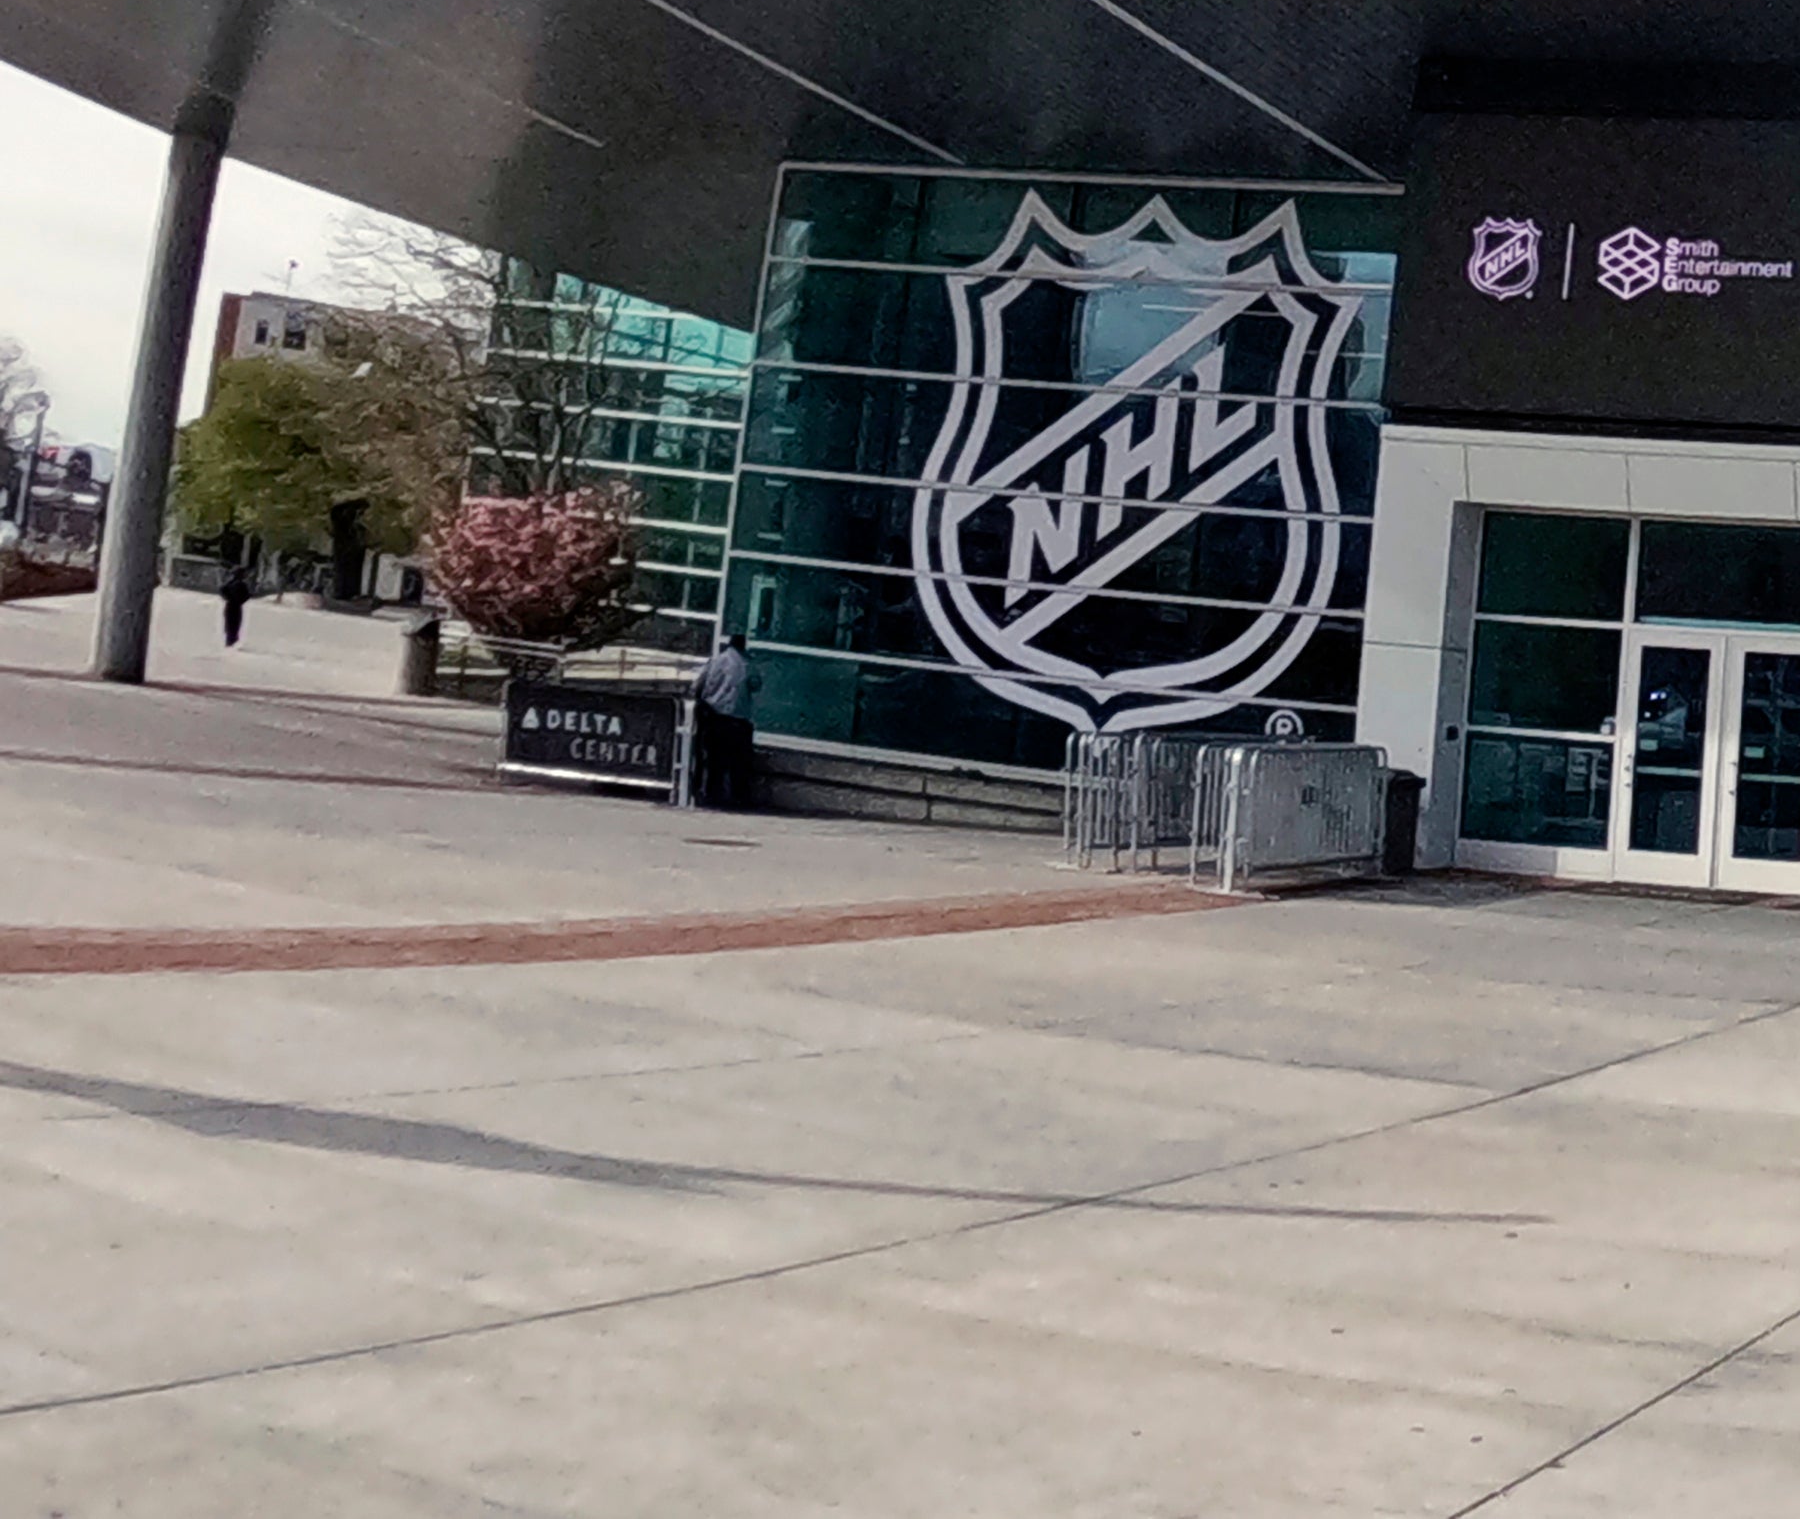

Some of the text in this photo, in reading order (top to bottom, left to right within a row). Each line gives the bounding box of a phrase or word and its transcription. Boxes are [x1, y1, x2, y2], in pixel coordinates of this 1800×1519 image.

[1483, 241, 1526, 280] NHL
[1665, 237, 1719, 257] Smith
[1664, 256, 1793, 278] Entertainment
[1662, 277, 1721, 296] Group
[1004, 343, 1257, 610] NHL
[546, 708, 622, 737] DELTA
[569, 737, 658, 767] CENTER
